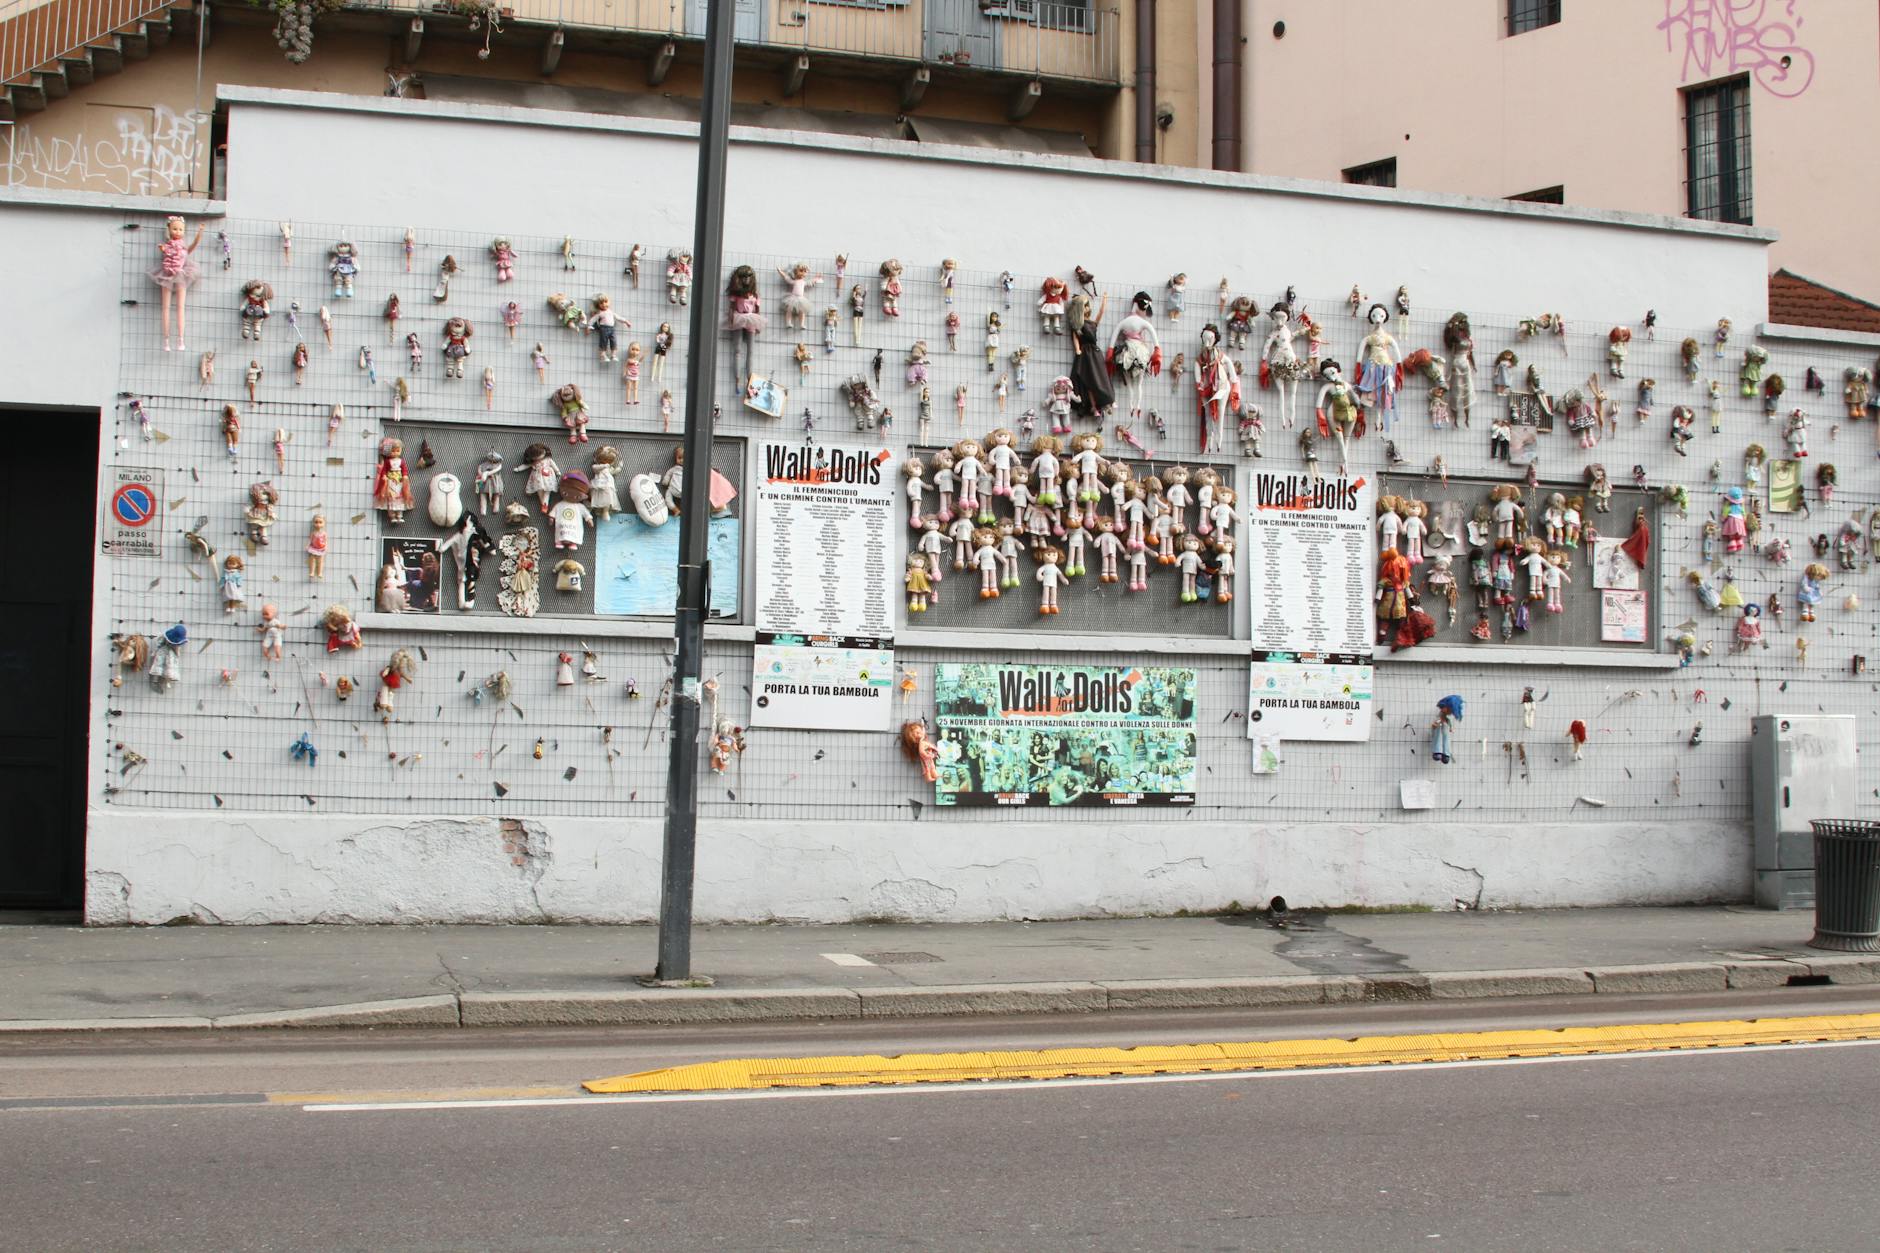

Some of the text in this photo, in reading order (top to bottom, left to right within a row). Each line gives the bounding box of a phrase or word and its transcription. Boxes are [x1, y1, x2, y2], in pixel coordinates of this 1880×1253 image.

[767, 445, 812, 481] Wall
[831, 449, 881, 485] Dolls
[793, 486, 858, 497] IL FEMMINICIDIO
[1257, 473, 1297, 508] Wall
[1313, 478, 1358, 511] Dolls
[768, 493, 779, 501] UN
[780, 494, 814, 502] CRIMINE
[816, 496, 848, 504] CONTRO
[1281, 512, 1338, 522] IL FEMMINICIDIO
[1270, 520, 1300, 528] CRIMINE
[1301, 521, 1329, 529] CONTRO
[118, 530, 147, 538] passo
[110, 539, 154, 548] carrabile
[764, 683, 879, 698] PORTA LA TUA BAMBOLA
[999, 670, 1052, 712] Wall
[1074, 672, 1132, 713] Dolls
[1260, 698, 1360, 710] PORTA LA TUA BAMBOLA
[938, 718, 948, 726] 25
[949, 718, 987, 726] NOVEMBRE
[988, 719, 1022, 727] GIORNATA
[1024, 719, 1080, 728] INTERNAZIONALE
[1081, 720, 1108, 728] CONTRO
[1110, 720, 1118, 728] LA
[1171, 721, 1193, 729] DONNE
